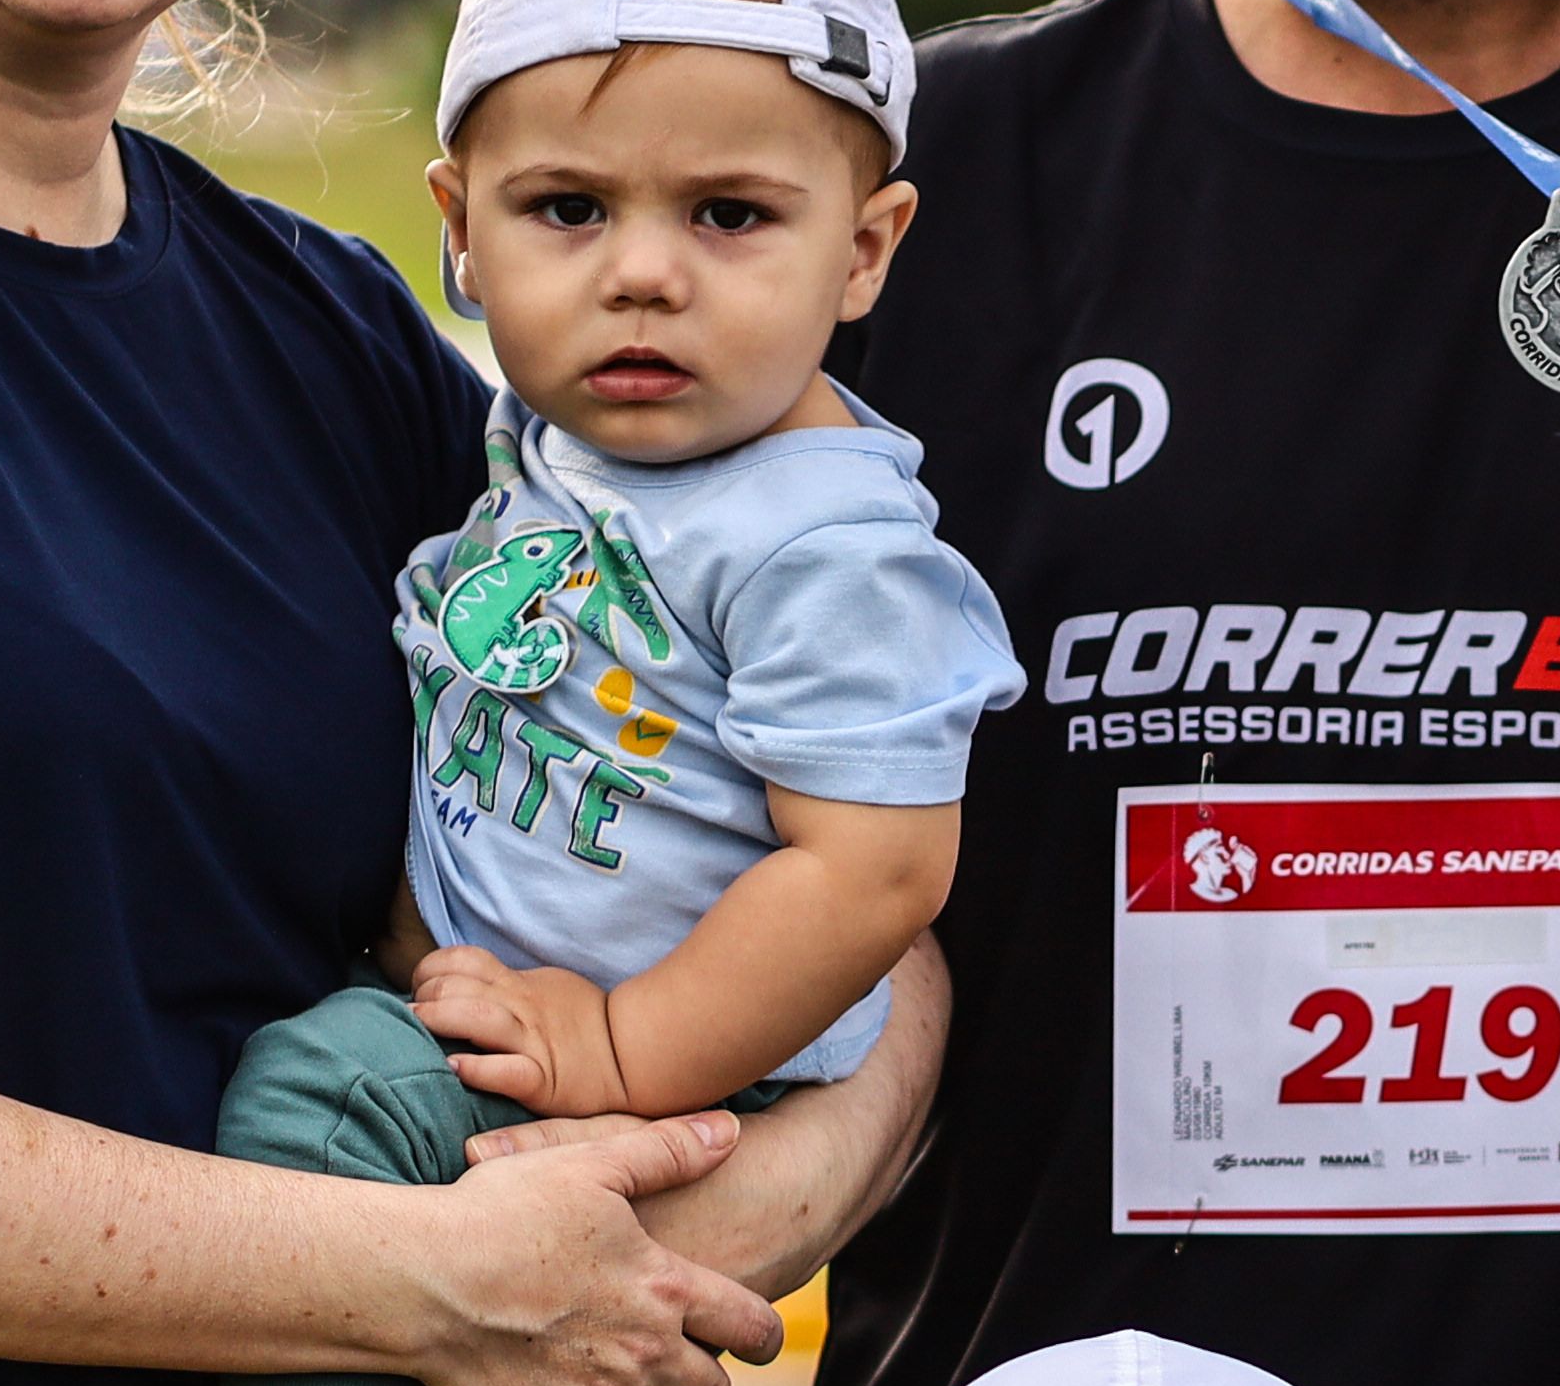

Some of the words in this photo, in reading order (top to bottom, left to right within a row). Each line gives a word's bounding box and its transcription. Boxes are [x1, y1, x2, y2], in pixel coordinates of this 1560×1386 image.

[1068, 706, 1404, 752] ASSESSORIA
[1271, 849, 1434, 878] CORRIDAS
[1173, 1005, 1182, 1031] LIMA
[1213, 1085, 1222, 1094] M
[1183, 1076, 1192, 1140] MASCULINO
[1203, 1092, 1212, 1140] CORRIDA
[1213, 1097, 1222, 1140] ADULTO
[1240, 1157, 1306, 1167] SANEPAR
